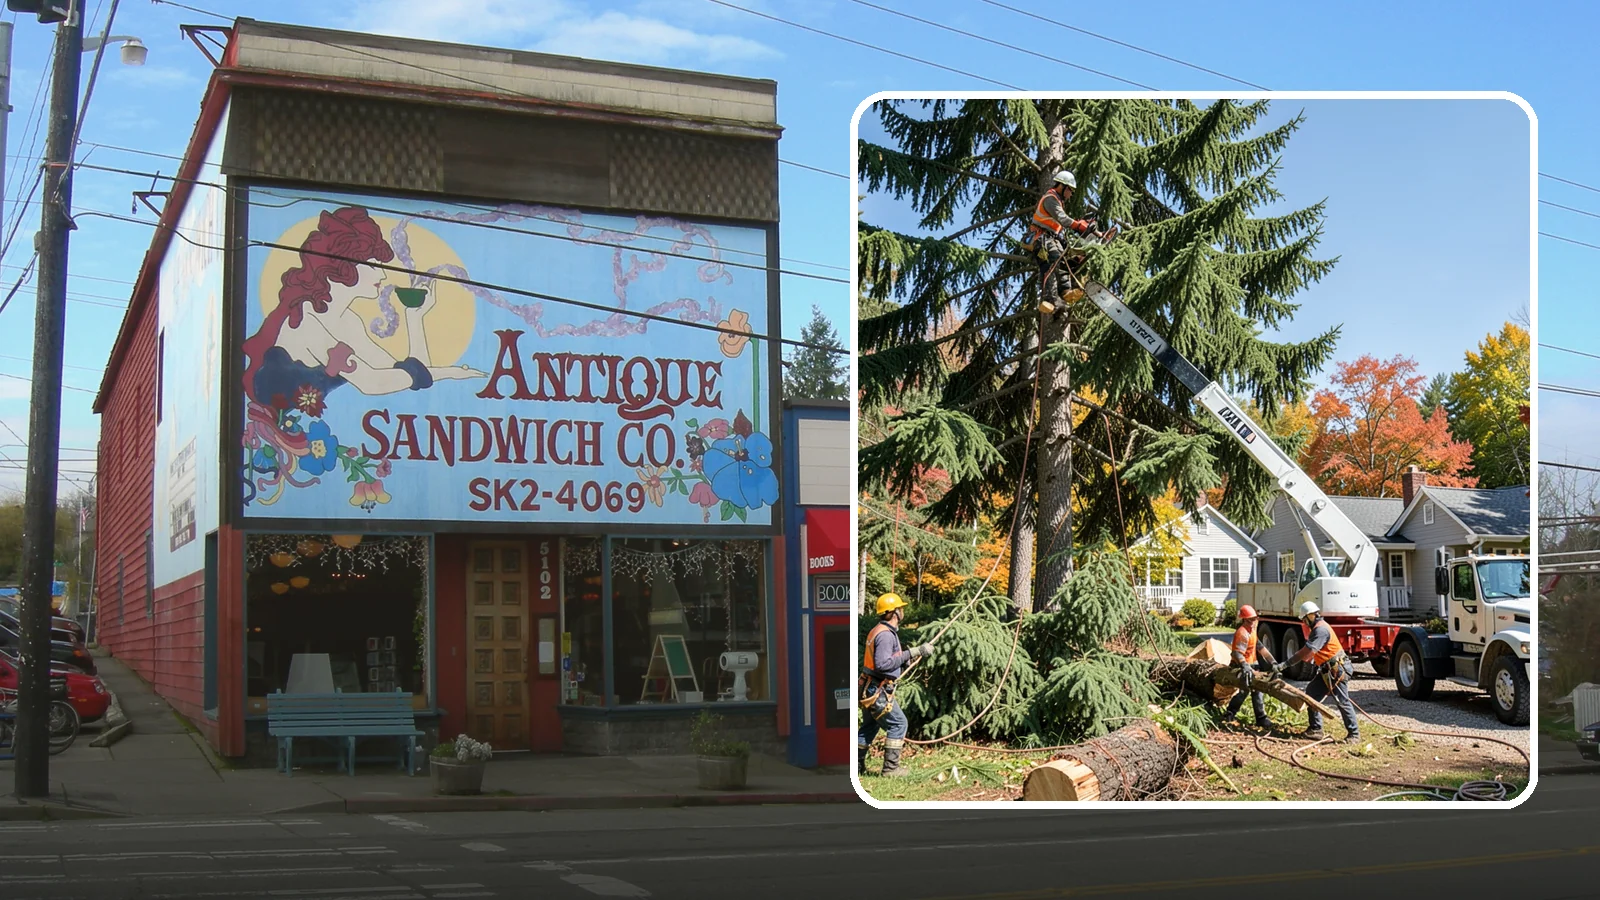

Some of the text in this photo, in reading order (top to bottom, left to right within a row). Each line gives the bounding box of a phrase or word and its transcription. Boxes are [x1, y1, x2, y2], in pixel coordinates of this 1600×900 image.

[361, 409, 685, 469] SANDWICH CO.
[468, 477, 646, 513] SK2-4069
[539, 541, 552, 600] 5102
[809, 555, 835, 569] BOOKS
